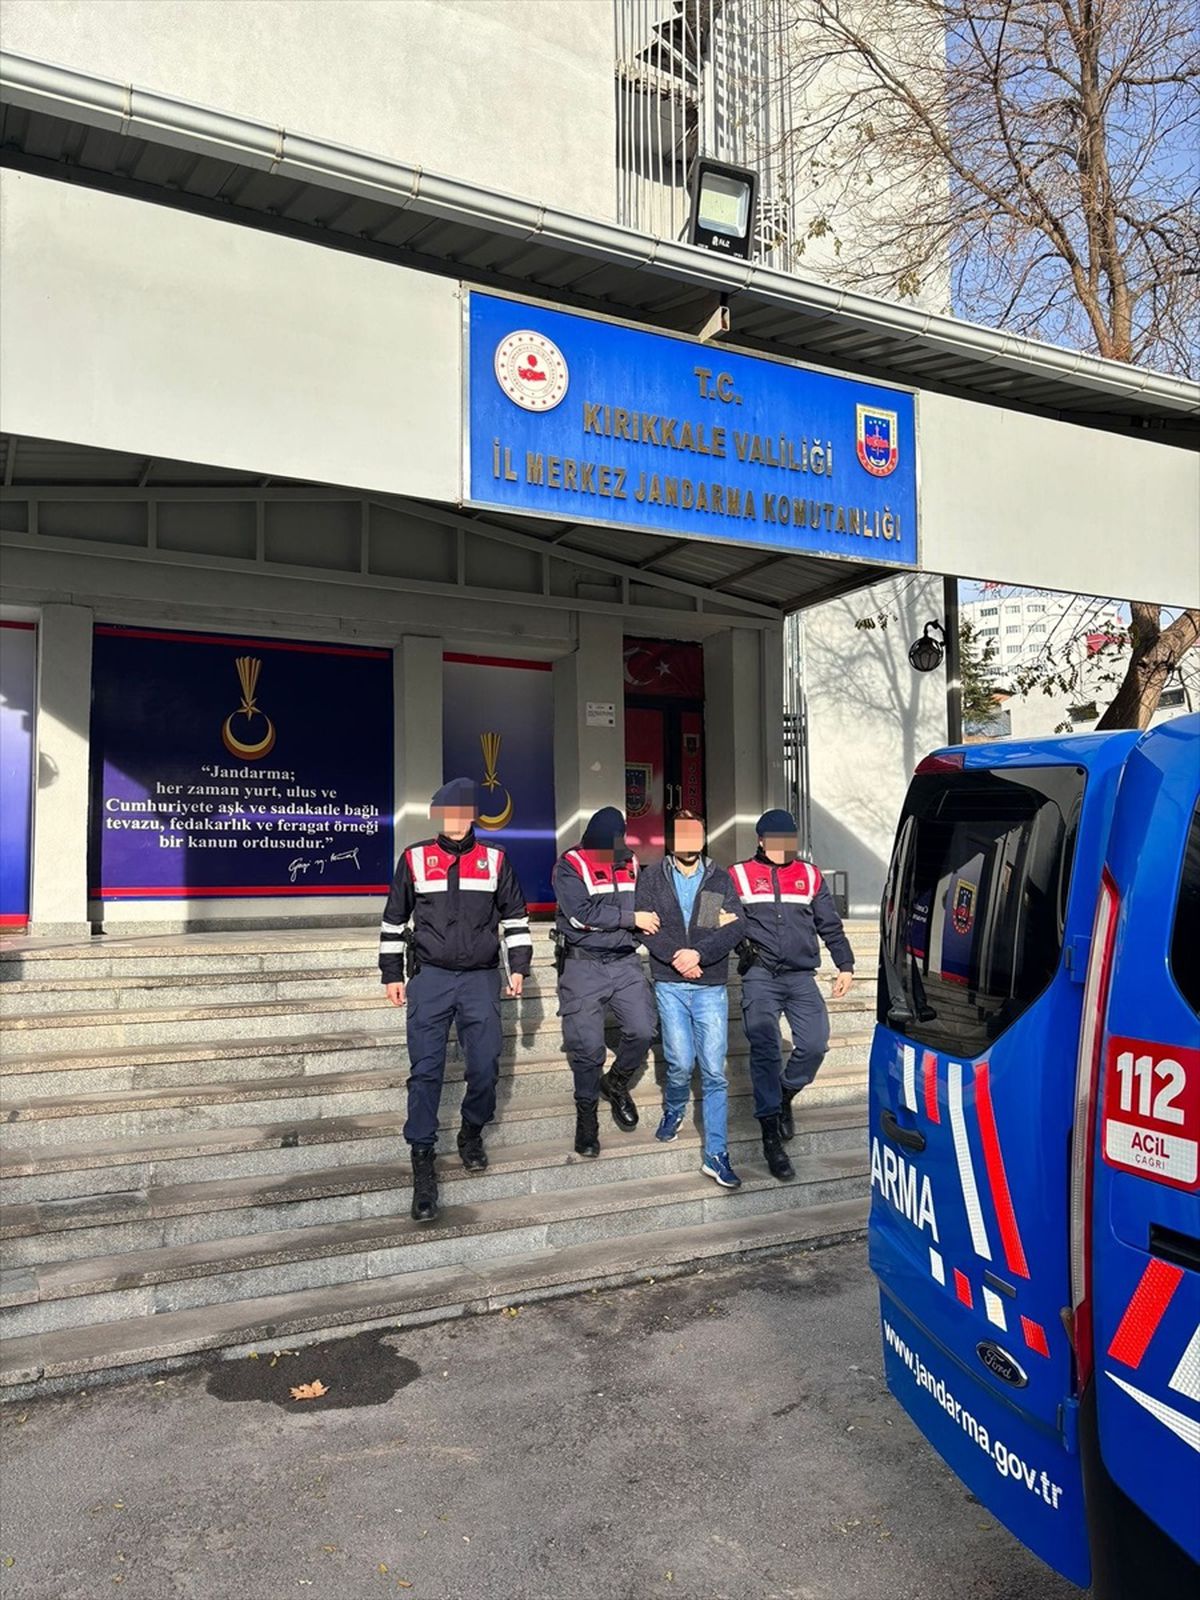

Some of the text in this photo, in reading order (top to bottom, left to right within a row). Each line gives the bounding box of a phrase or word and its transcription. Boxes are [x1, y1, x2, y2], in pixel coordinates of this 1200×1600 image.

[695, 366, 742, 406] T.C.
[583, 401, 726, 458] KIRIKKALE
[733, 430, 833, 478] VALİLİĞİ
[493, 437, 901, 542] İL MERKEZ JANDARMA KOMUTANLIĞI
[105, 798, 379, 819] Cumhuriyete aşk ve sadakatle bağlı
[156, 782, 337, 800] her zaman yurt, ulus ve
[106, 817, 379, 836] tevazu, fedakarlık ve feragat örneği
[159, 835, 184, 848] bir
[188, 836, 238, 848] kanun
[1116, 1051, 1187, 1126] 112
[870, 1136, 940, 1244] ARMA
[984, 1350, 1012, 1380] Ford
[883, 1319, 1063, 1510] www.jandarma.gov.tr
